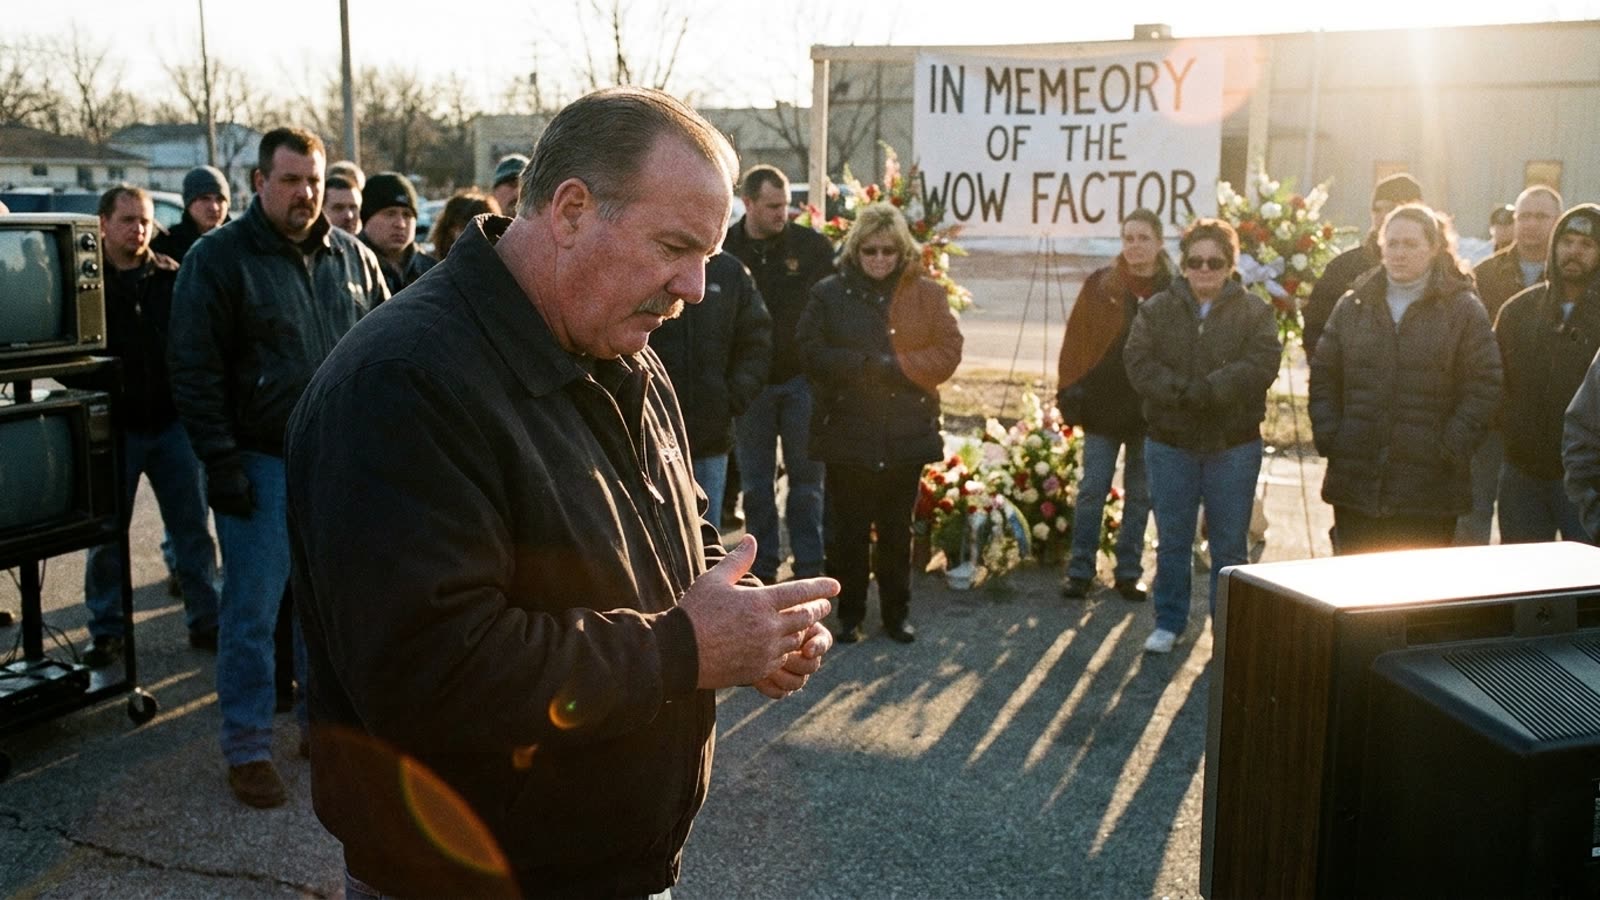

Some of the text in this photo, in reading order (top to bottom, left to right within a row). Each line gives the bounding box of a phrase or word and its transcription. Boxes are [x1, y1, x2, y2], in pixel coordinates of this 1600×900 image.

[929, 57, 1196, 115] IN MEMEORY
[986, 122, 1128, 162] OF THE
[920, 169, 1196, 225] WOW FACTOR
